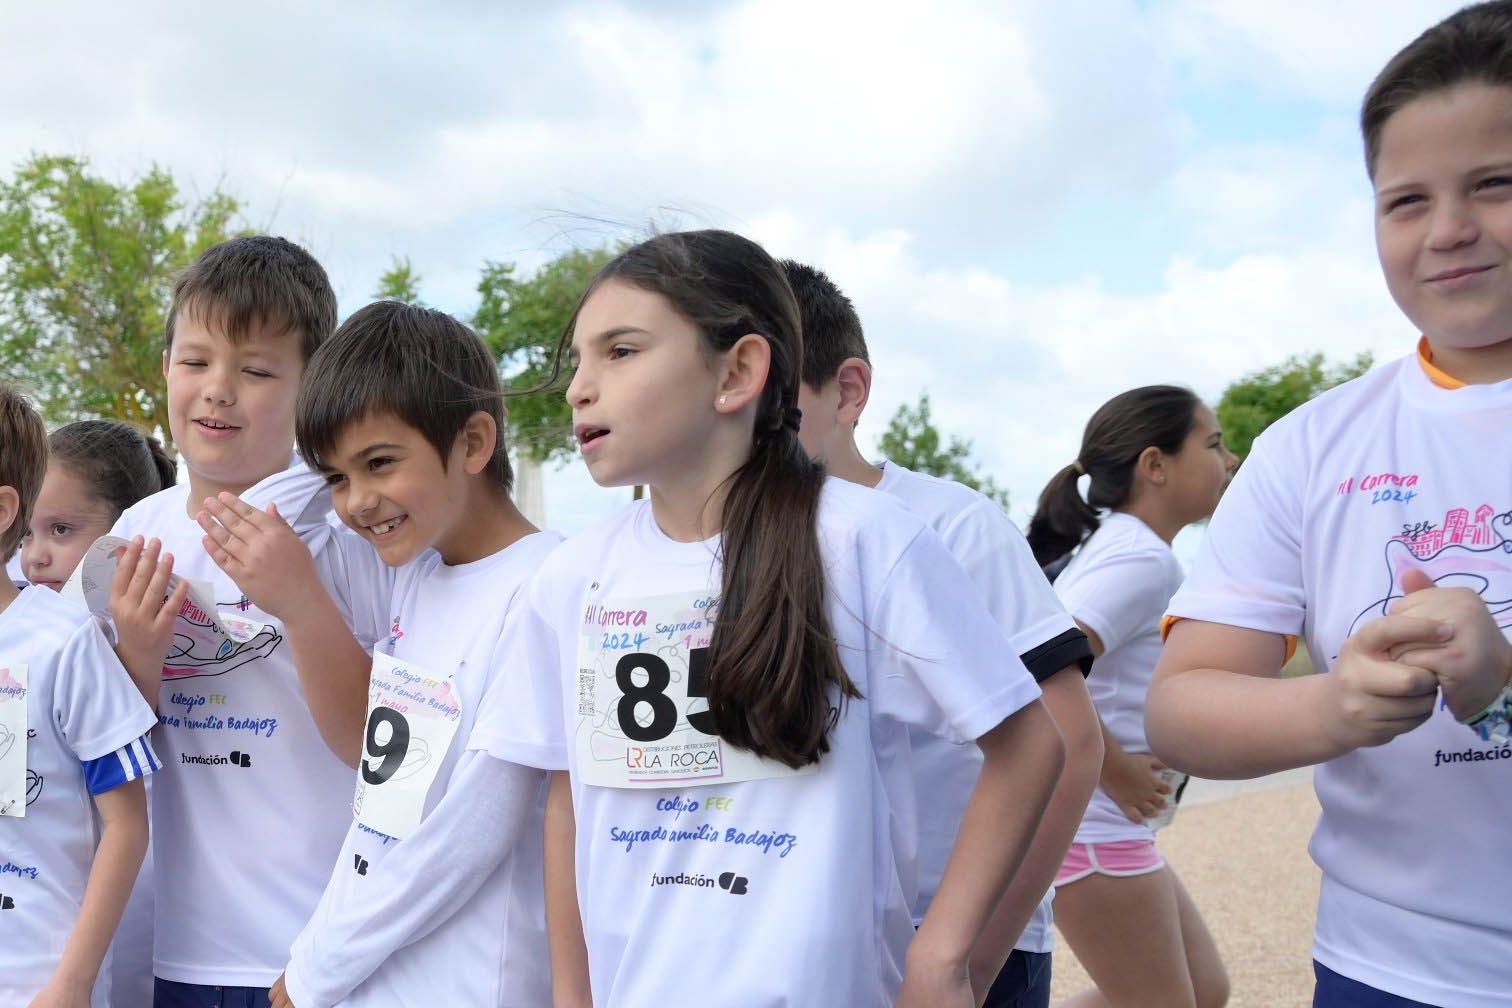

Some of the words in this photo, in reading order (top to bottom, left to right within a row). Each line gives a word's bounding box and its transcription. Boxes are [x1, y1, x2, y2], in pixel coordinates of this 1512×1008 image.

[1360, 473, 1419, 491] Carrera
[1372, 489, 1418, 504] 2024
[597, 606, 648, 628] Carrera
[656, 619, 702, 641] Sagrada
[602, 632, 650, 650] 2024
[391, 666, 422, 684] Colegio
[393, 685, 427, 703] Familia
[615, 647, 720, 742] 85
[227, 717, 278, 738] Badajoz
[644, 755, 662, 768] LA
[670, 750, 719, 767] ROCA
[1434, 744, 1512, 767] fundació
[724, 828, 798, 858] Badajoz
[650, 873, 715, 888] fundación
